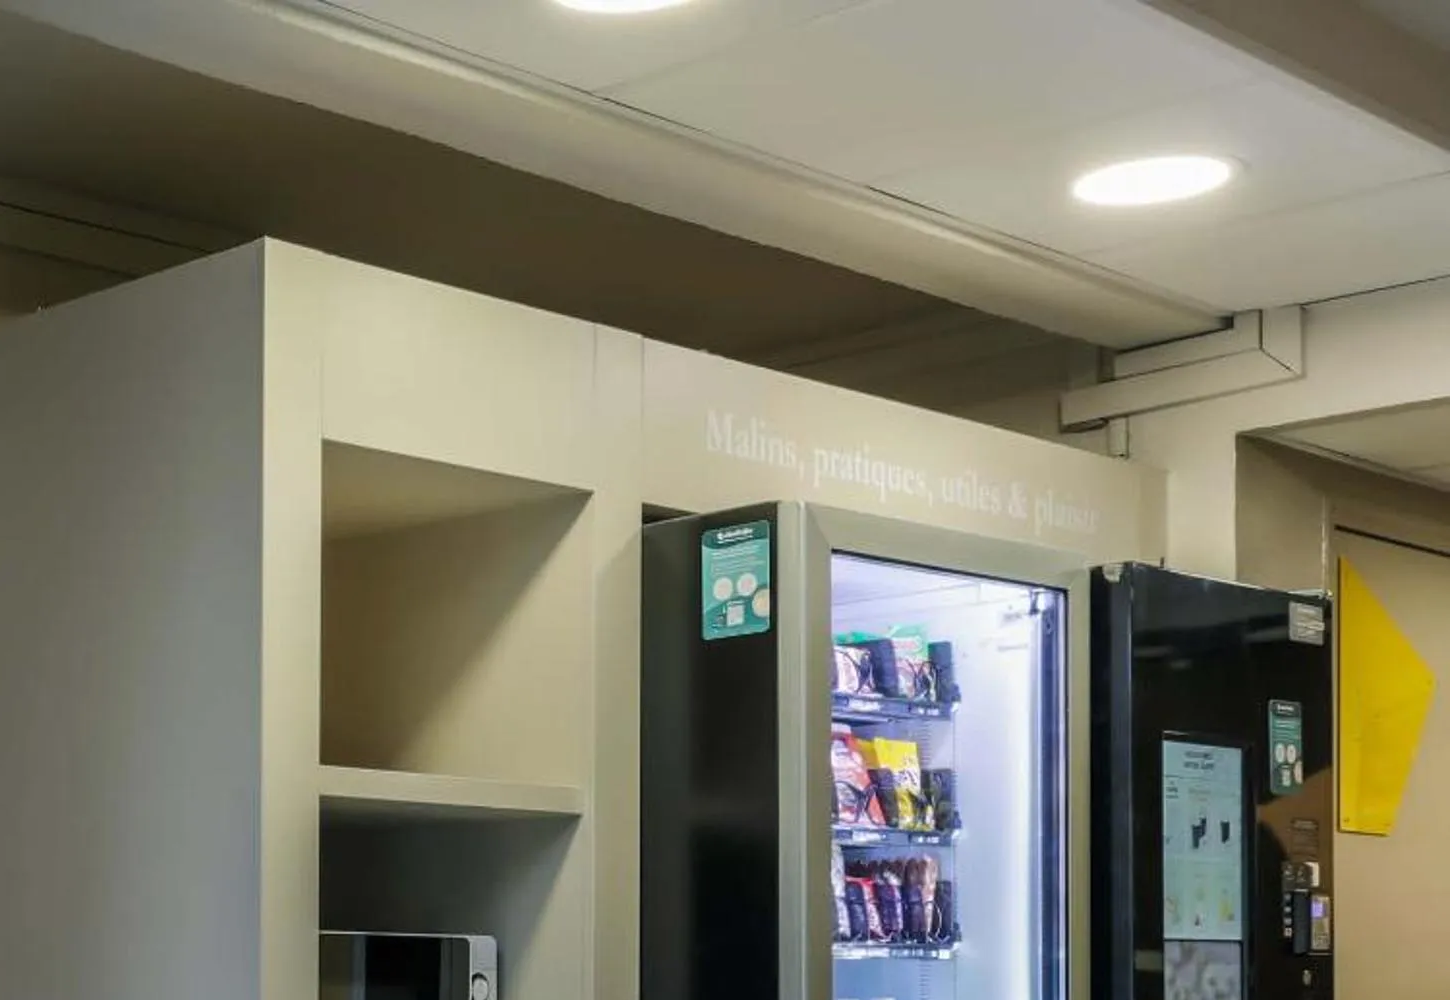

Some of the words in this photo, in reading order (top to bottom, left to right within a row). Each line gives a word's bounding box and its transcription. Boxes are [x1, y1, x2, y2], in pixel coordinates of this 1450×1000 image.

[705, 408, 805, 480] Malins,
[813, 441, 933, 508] pratiques,
[939, 466, 1001, 516] utiles
[1003, 479, 1028, 519] &
